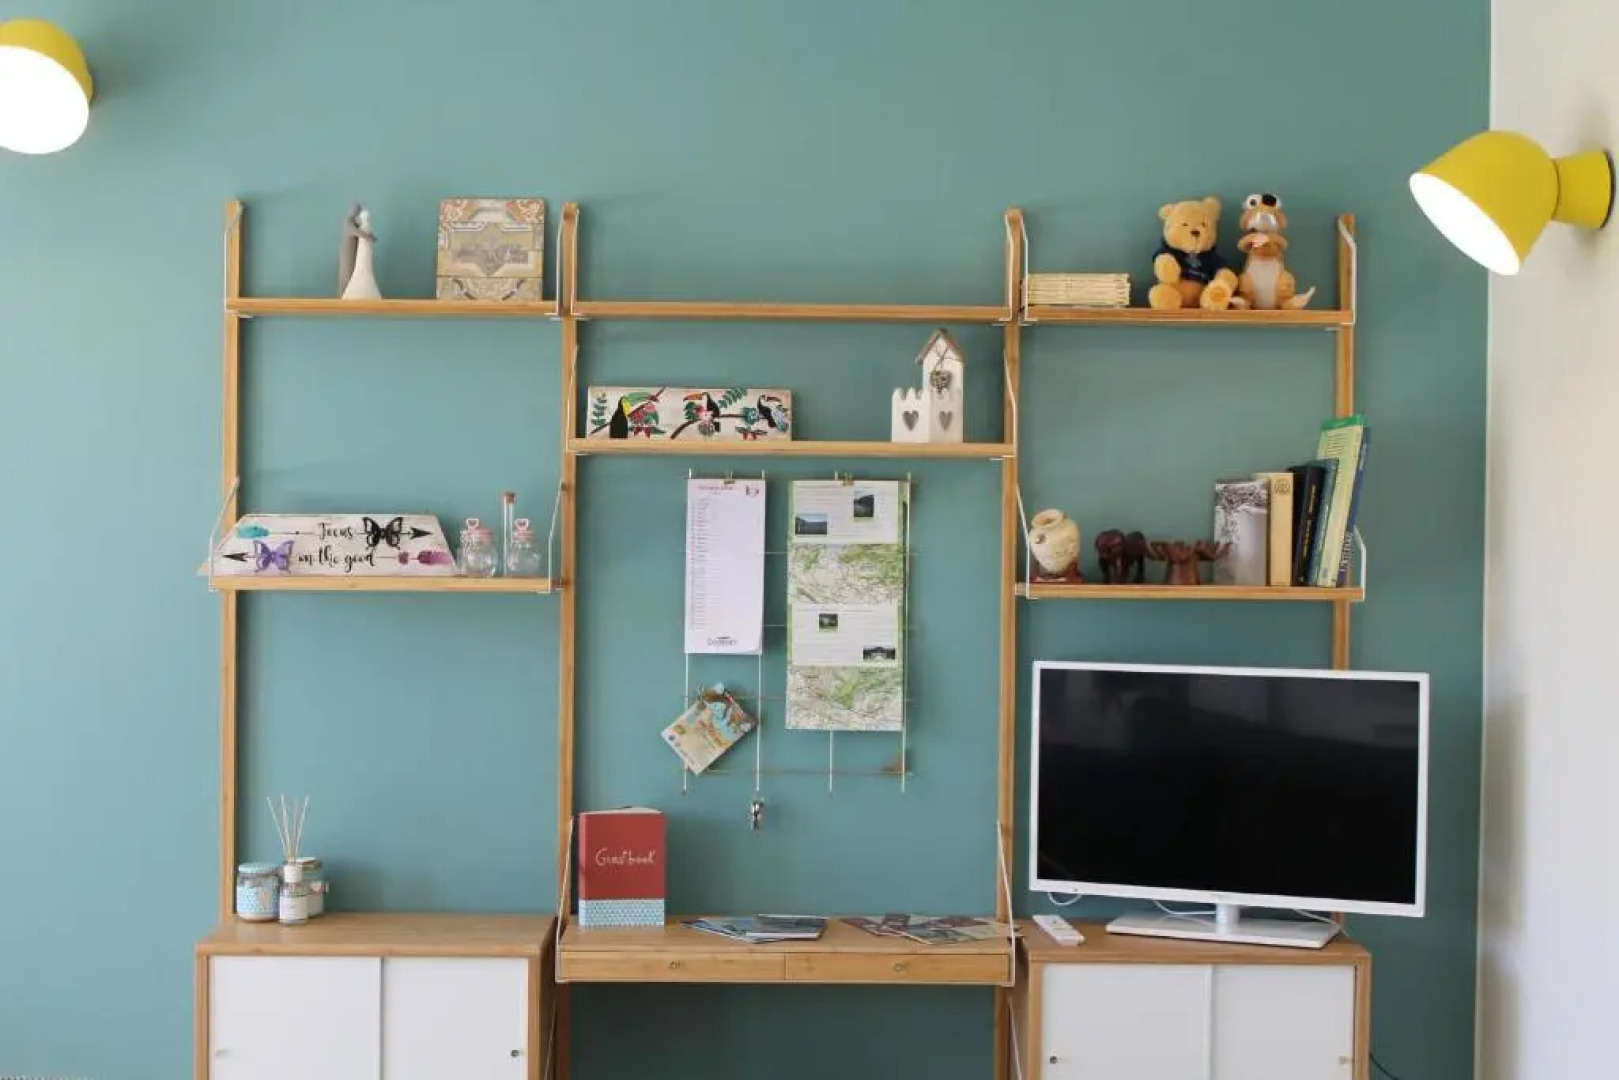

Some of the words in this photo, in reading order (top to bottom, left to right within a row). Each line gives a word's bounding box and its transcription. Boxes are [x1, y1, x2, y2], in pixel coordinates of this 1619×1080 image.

[318, 545, 338, 568] the
[344, 547, 376, 573] good
[595, 848, 655, 866] Guestbook
